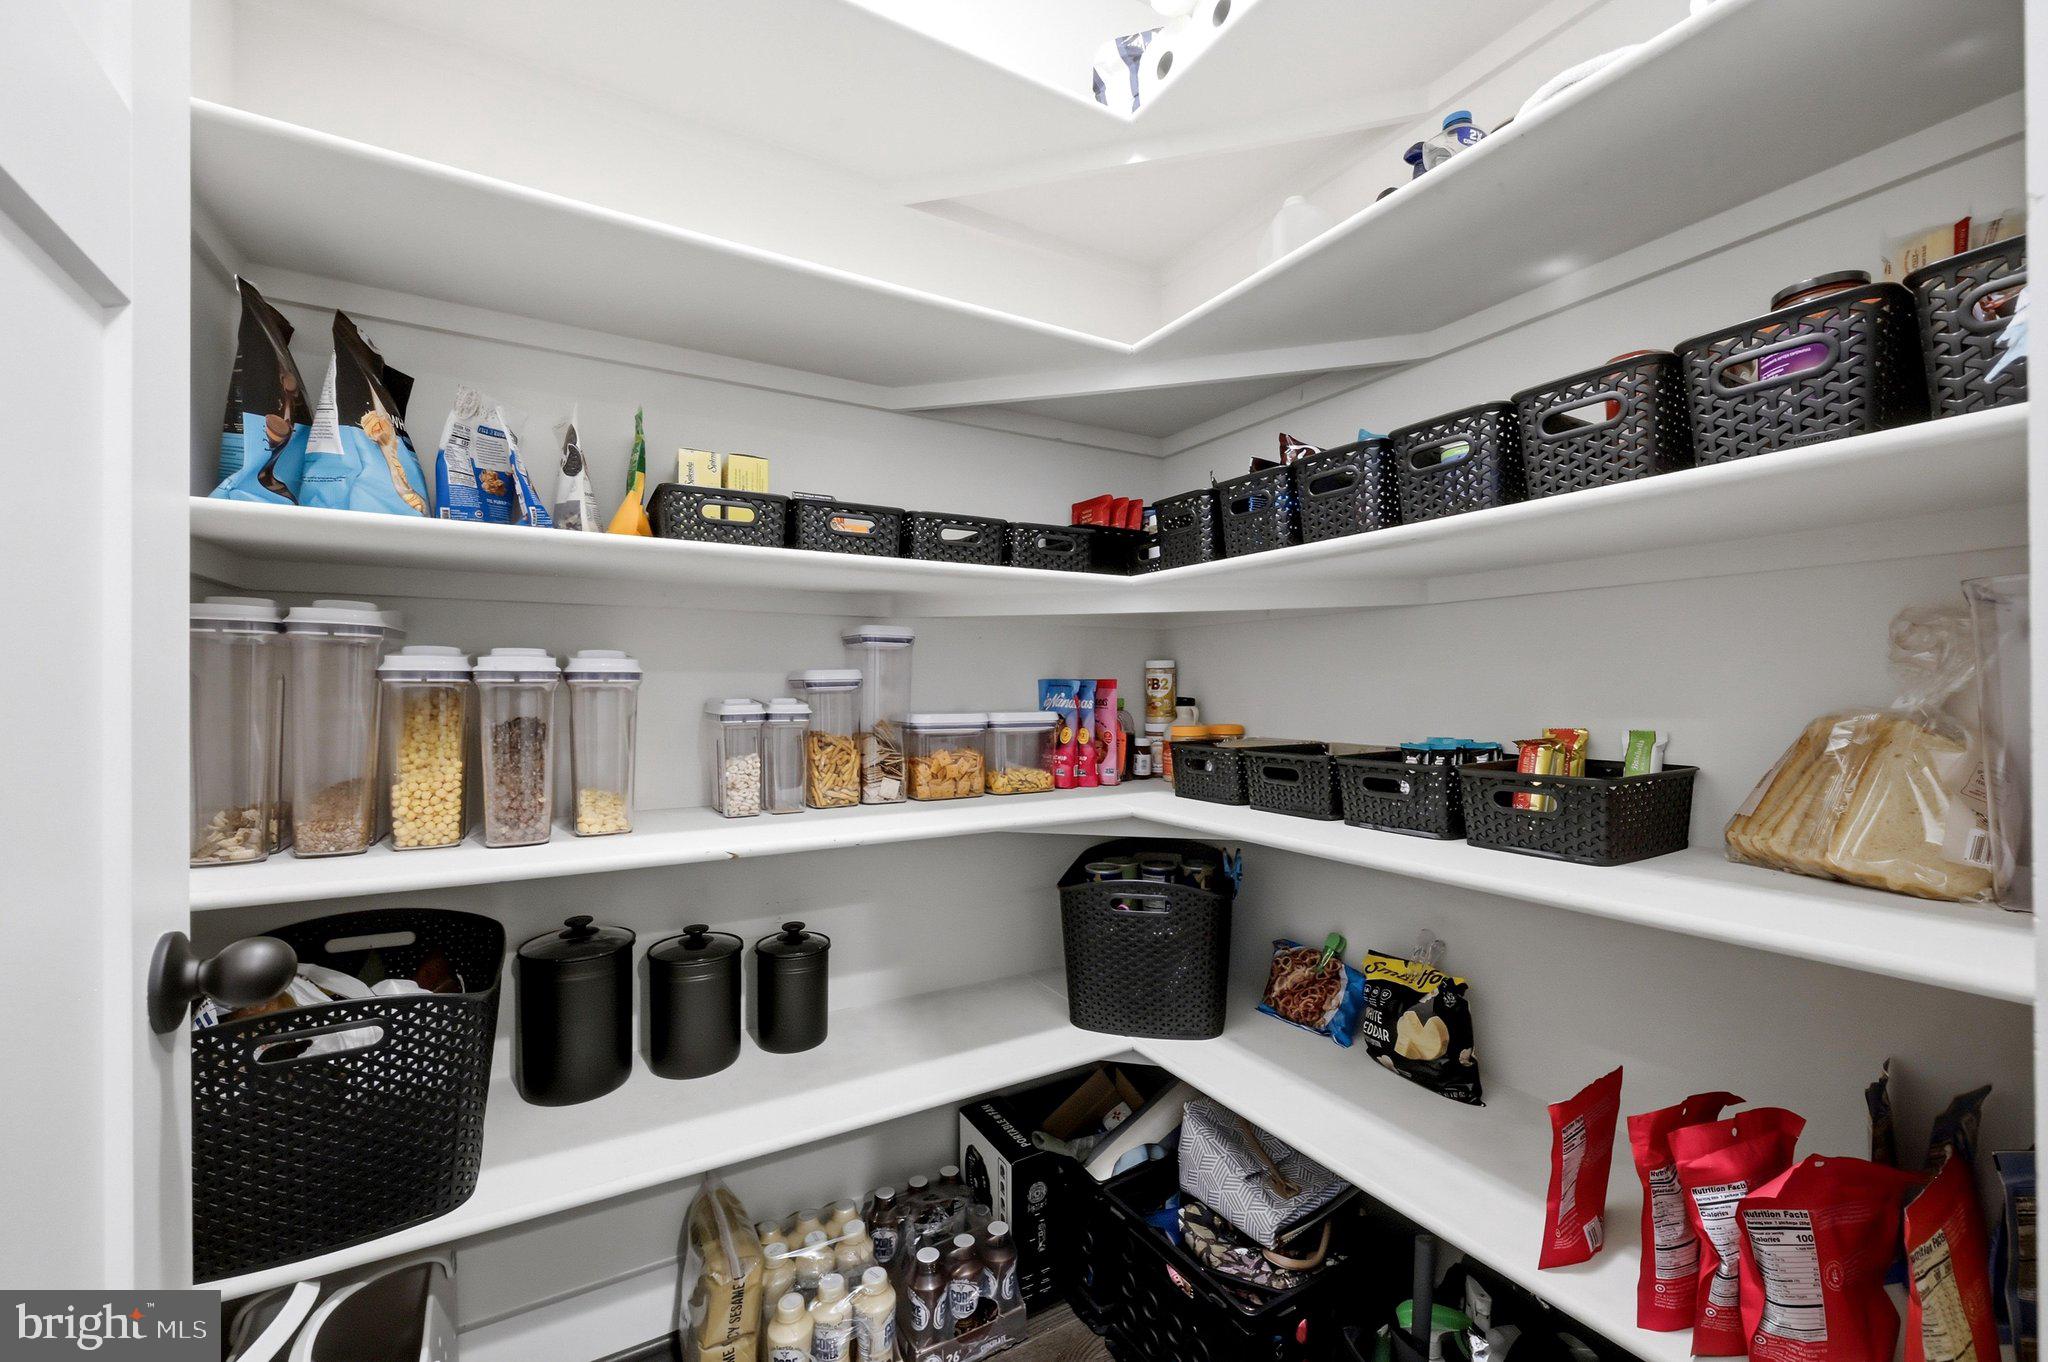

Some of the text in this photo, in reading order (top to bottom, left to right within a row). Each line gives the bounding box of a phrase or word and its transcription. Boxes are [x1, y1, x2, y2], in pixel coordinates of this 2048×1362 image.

[1365, 1006, 1383, 1025] HITE
[1363, 1020, 1391, 1043] EDDAR
[1692, 1186, 1726, 1195] Nutrition
[1743, 1210, 1781, 1218] Nutrition
[1750, 1233, 1814, 1243] Calories 100
[729, 1282, 746, 1324] SESAME
